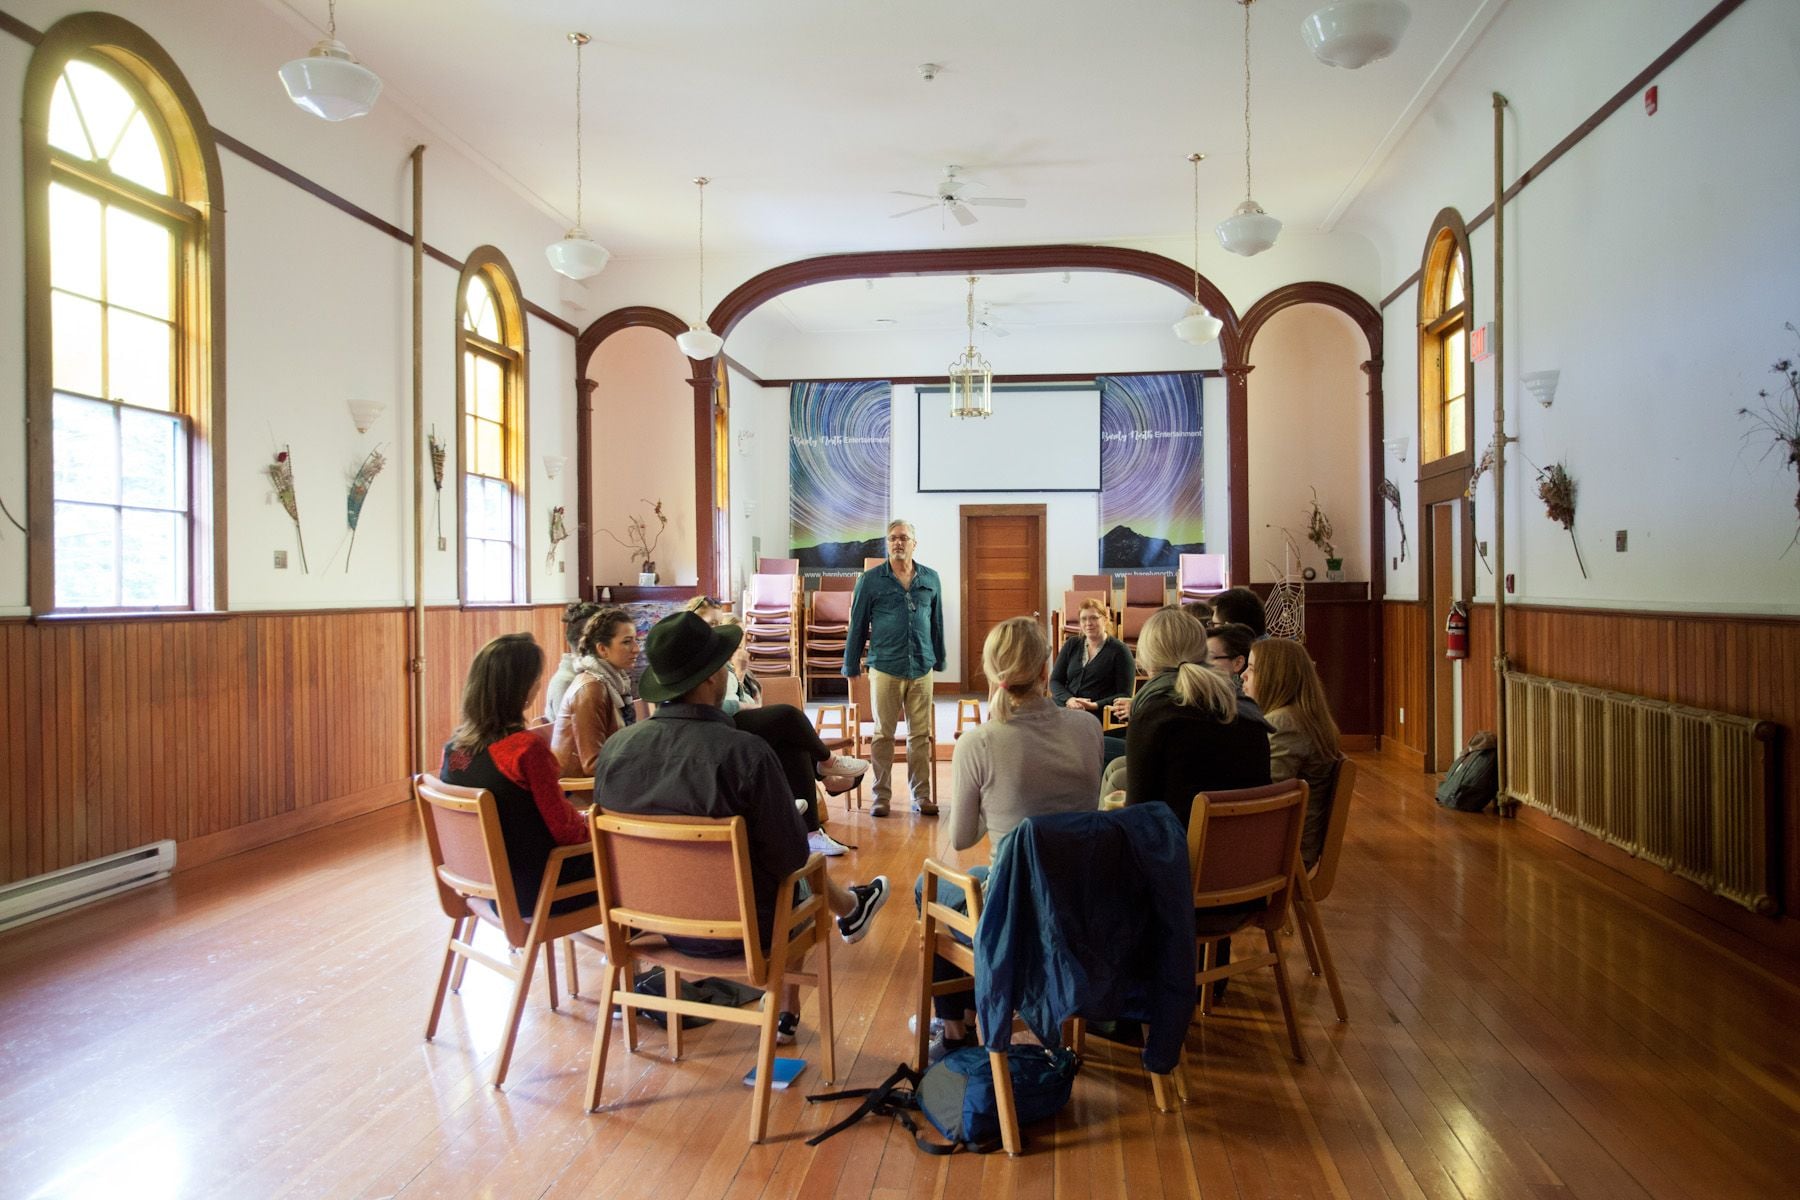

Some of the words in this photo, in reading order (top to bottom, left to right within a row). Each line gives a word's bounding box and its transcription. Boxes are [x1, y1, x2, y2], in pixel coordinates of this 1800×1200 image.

[1471, 326, 1485, 358] EXIT
[821, 435, 843, 446] North
[844, 436, 890, 444] Entertainment
[1128, 430, 1153, 441] North
[1155, 430, 1202, 438] Entertainment
